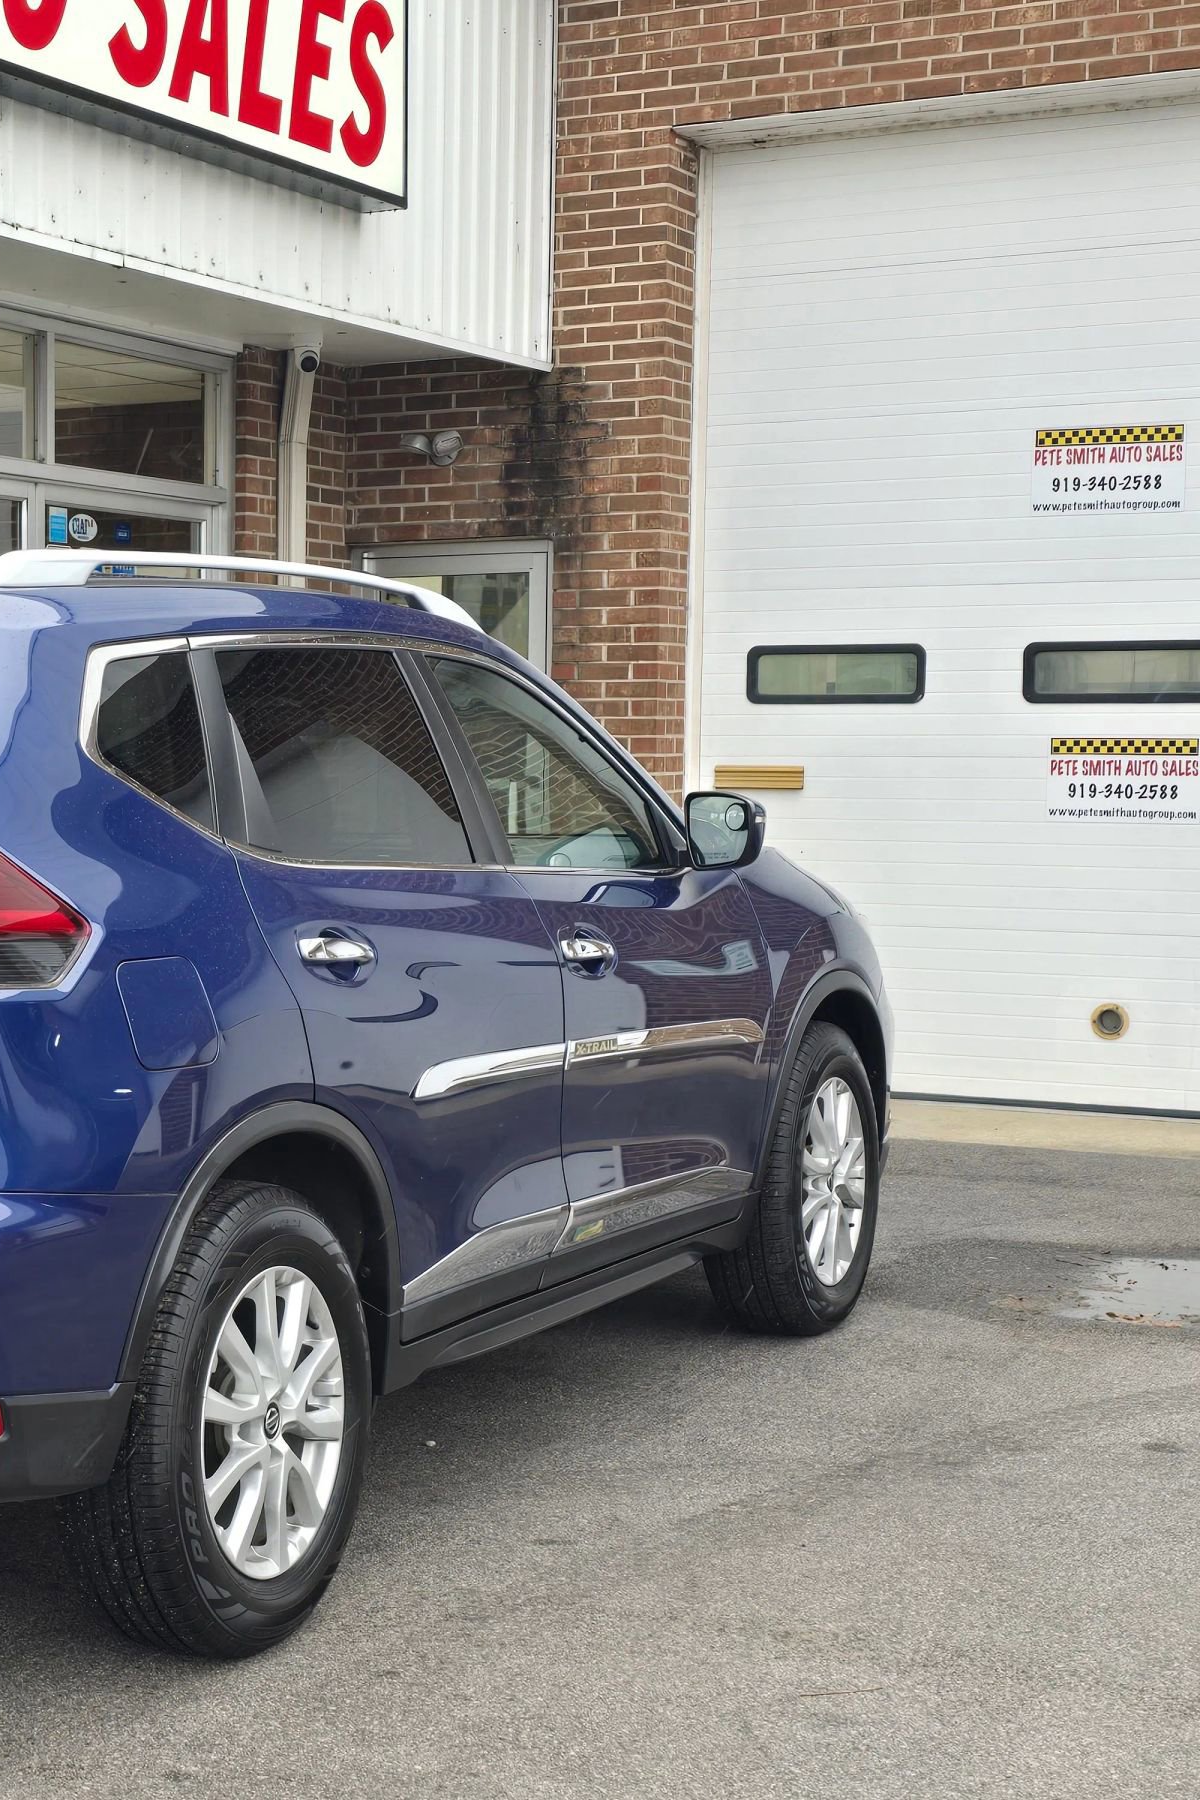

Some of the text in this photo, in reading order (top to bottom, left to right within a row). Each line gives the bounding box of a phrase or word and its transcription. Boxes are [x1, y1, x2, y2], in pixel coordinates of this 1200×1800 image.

[1035, 444, 1183, 466] PETE SMITH AUTO SALES
[1052, 474, 1162, 492] 919-340-2588
[1033, 500, 1181, 513] www.petesmithautogroup.com
[1050, 759, 1200, 777] PETE SMITH AUTO SALES
[1068, 782, 1178, 799] 919-340-2588
[1048, 807, 1197, 820] www.petesmithautogroup.com
[575, 1039, 618, 1056] X-TRAIL
